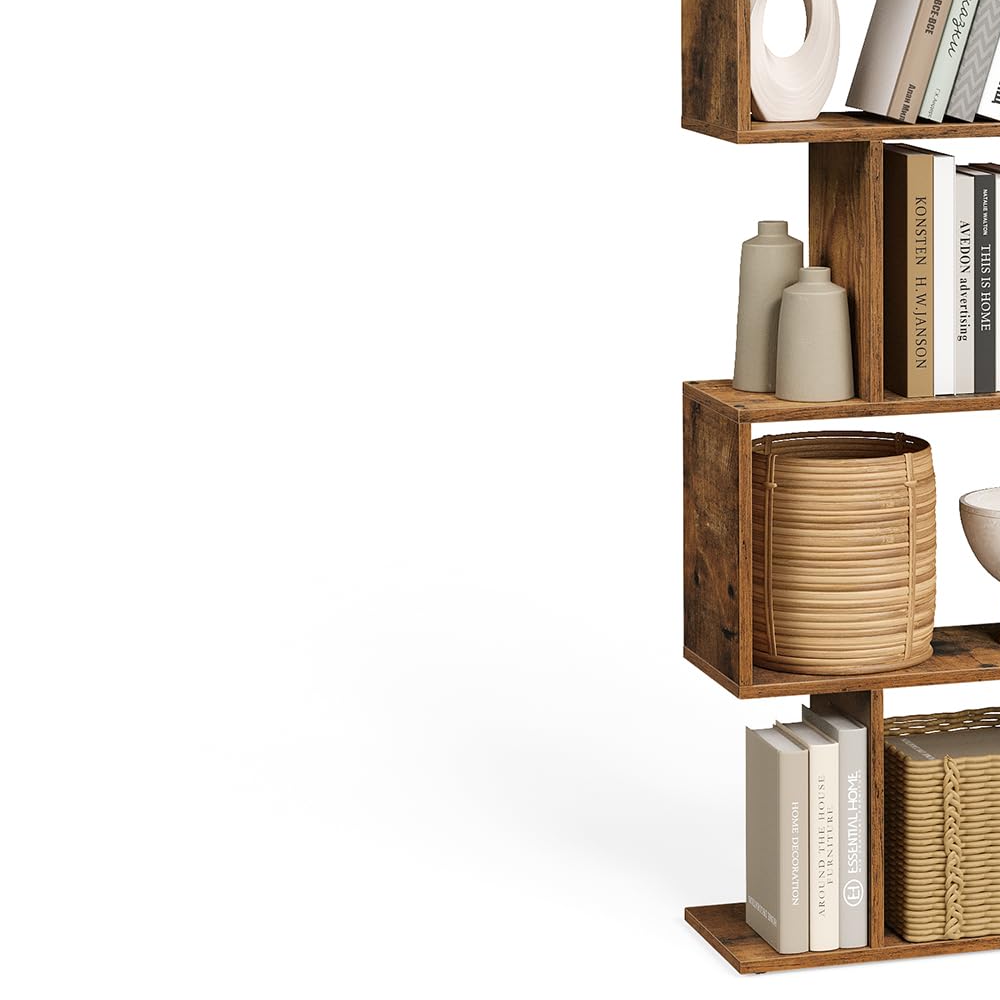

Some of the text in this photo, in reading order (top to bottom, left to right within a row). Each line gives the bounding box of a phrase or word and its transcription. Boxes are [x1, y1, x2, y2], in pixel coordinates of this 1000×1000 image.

[915, 197, 927, 265] KONSTEN
[957, 220, 971, 341] AVEDON advertising
[980, 243, 991, 331] THIS IS HOME
[791, 801, 799, 905] HOME DECORATION
[847, 770, 857, 873] ESSENTIAL HOME
